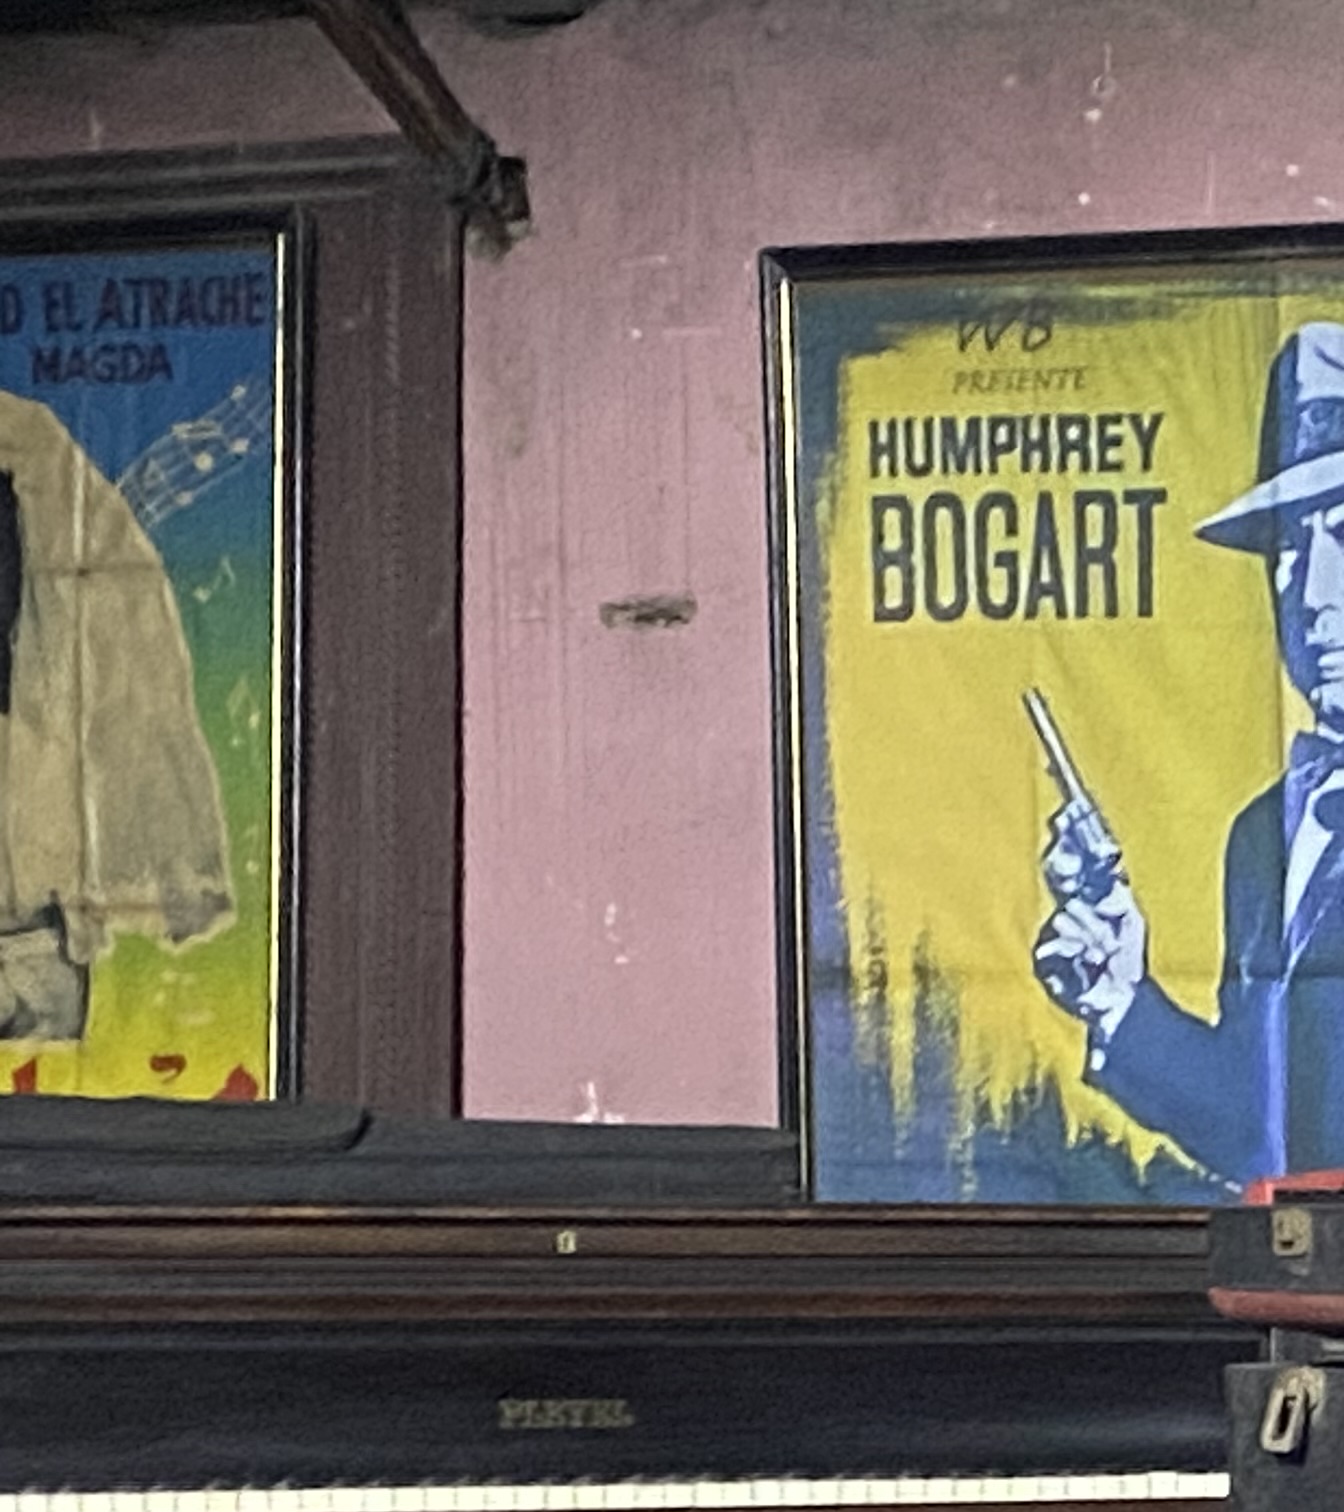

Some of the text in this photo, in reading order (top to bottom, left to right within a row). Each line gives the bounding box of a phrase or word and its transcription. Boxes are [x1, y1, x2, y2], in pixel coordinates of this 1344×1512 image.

[42, 280, 84, 332] EL
[93, 271, 267, 331] ATRACHE
[32, 342, 174, 385] MAGDA
[868, 411, 1166, 478] HUMPHREY
[870, 487, 1168, 622] BOGART
